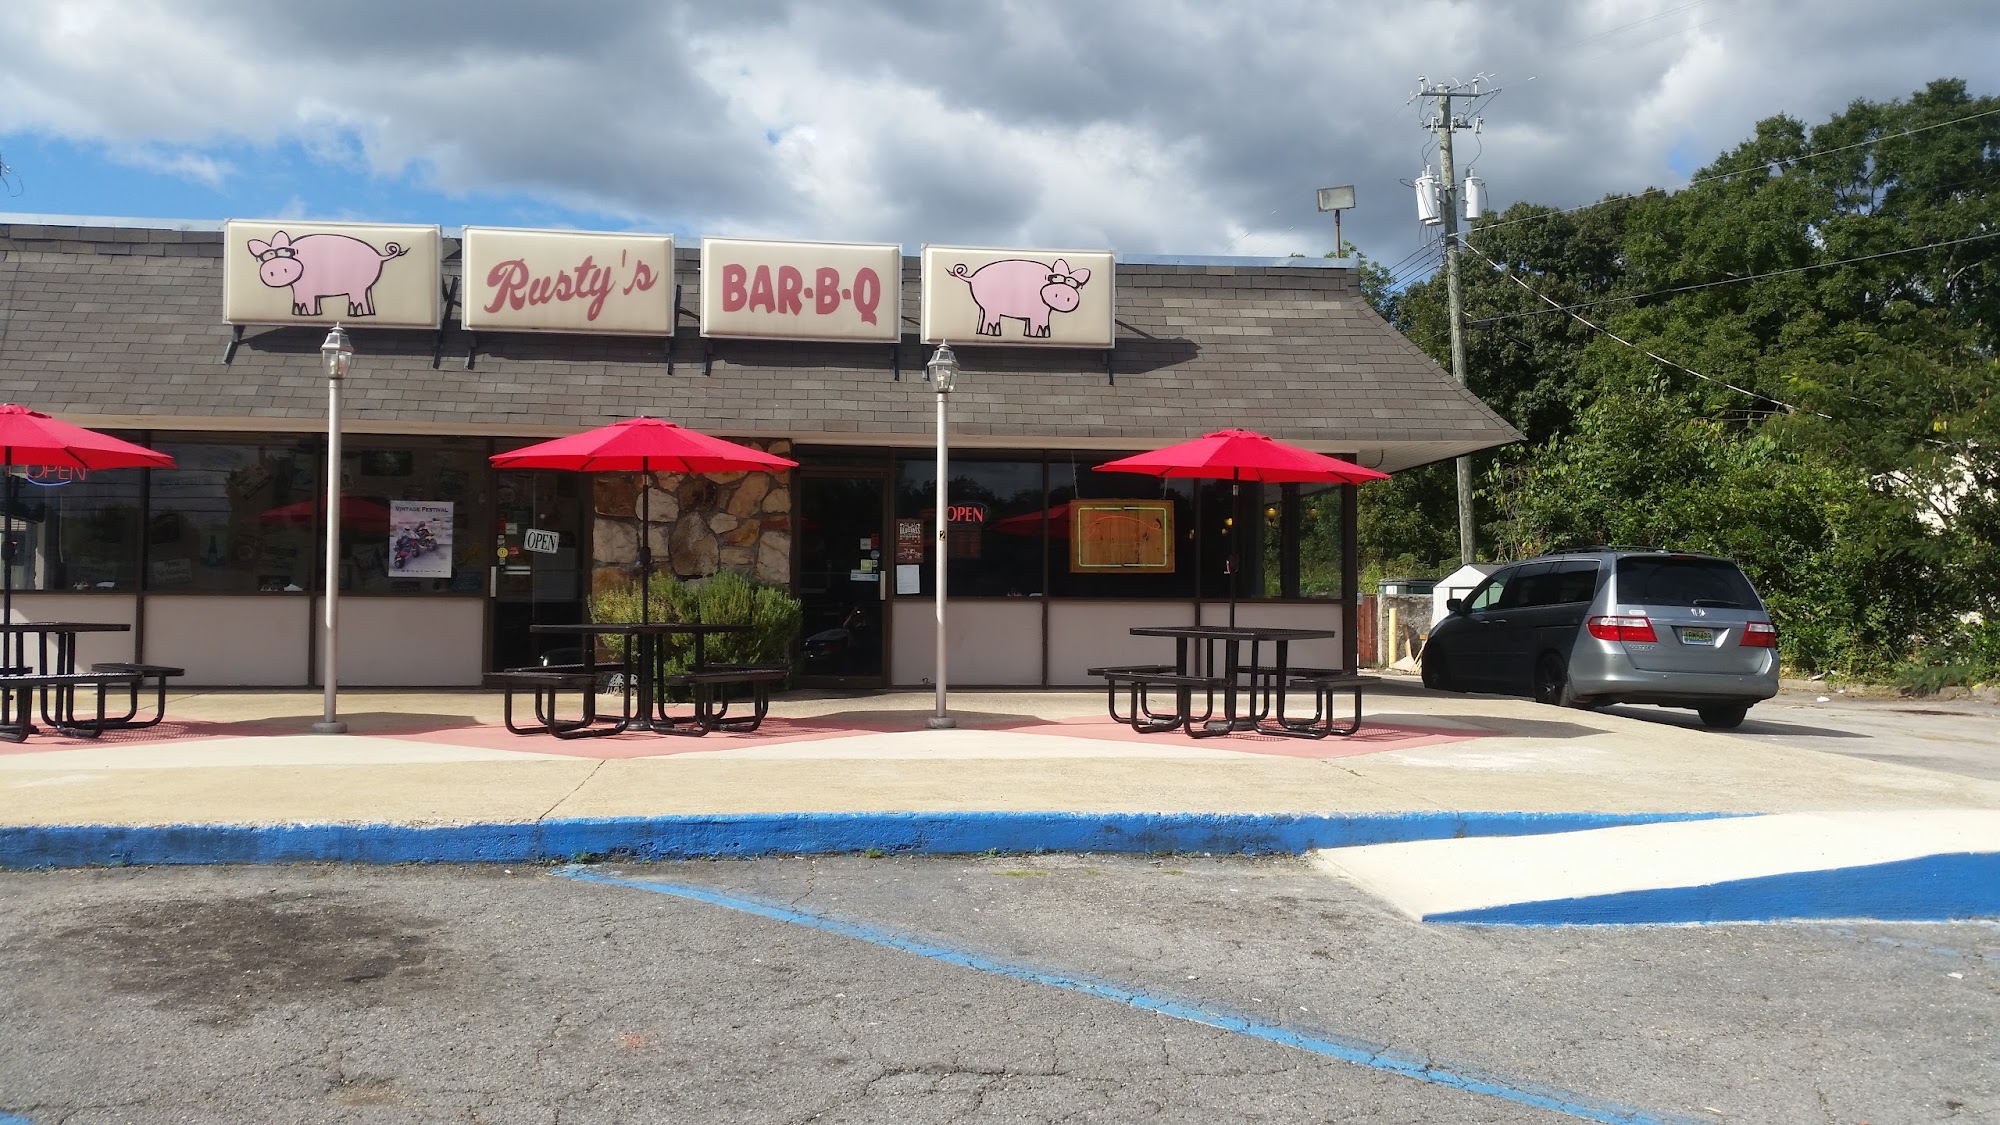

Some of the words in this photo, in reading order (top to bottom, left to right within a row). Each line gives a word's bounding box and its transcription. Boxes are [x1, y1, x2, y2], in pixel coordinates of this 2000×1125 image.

[484, 249, 659, 321] Rusty's
[722, 263, 881, 326] BAR-B-Q
[25, 465, 87, 481] OPEN
[946, 506, 984, 522] OPEN
[527, 531, 557, 551] OPEN
